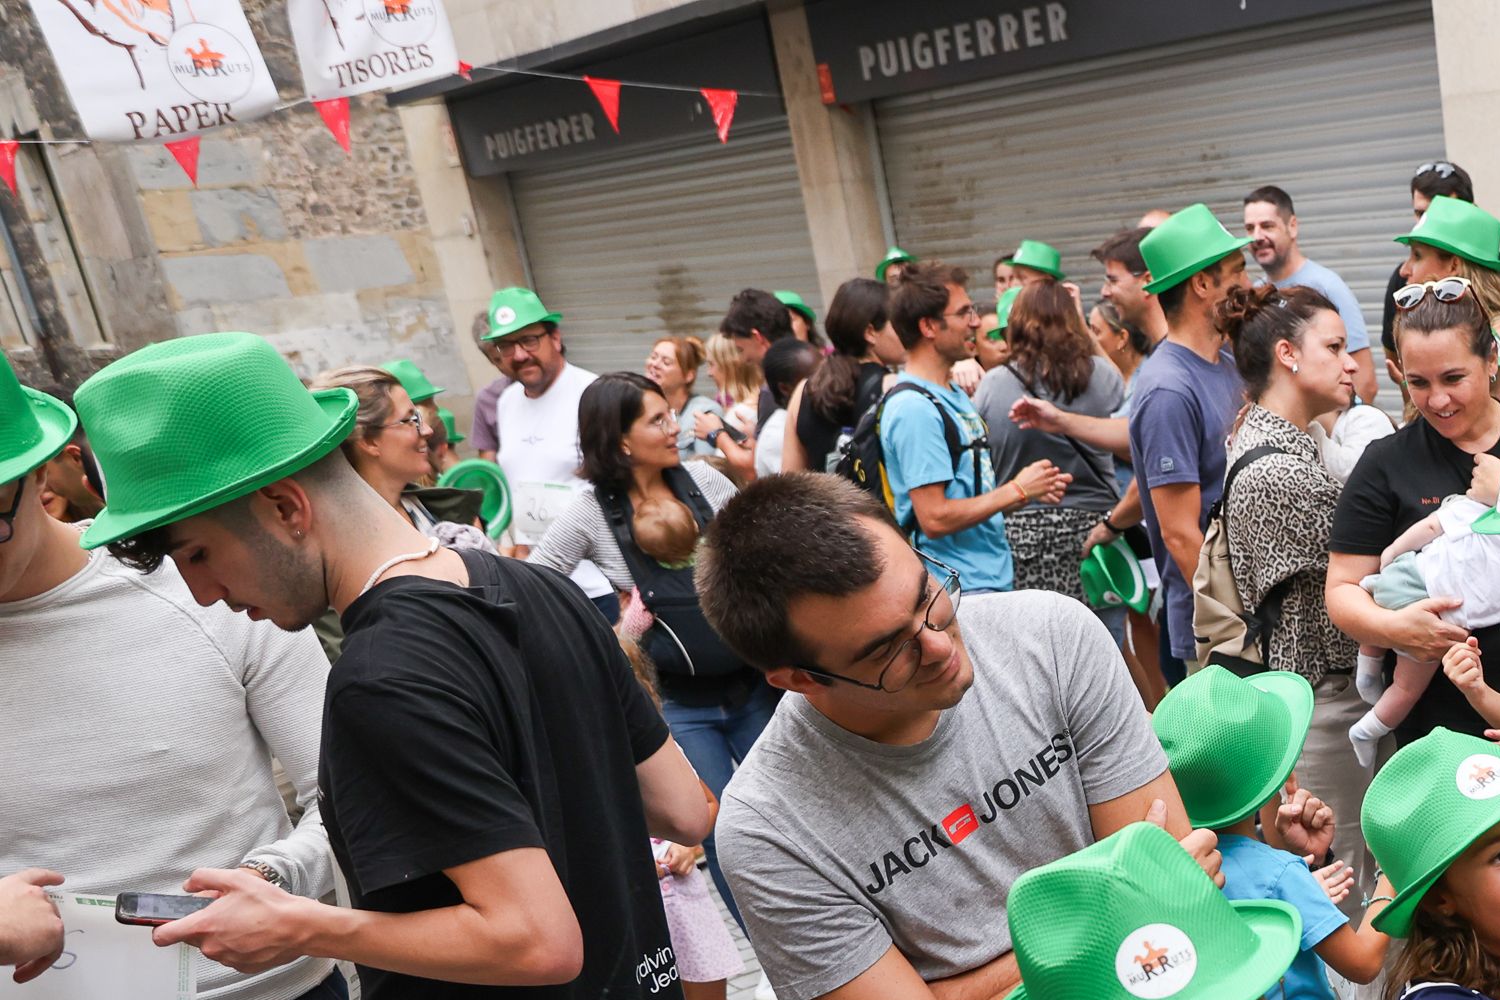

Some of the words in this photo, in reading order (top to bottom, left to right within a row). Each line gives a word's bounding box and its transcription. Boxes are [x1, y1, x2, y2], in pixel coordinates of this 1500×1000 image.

[857, 2, 1068, 81] PUIGFERRER
[329, 43, 435, 88] TISORES
[125, 100, 238, 140] PAPER
[864, 825, 953, 895] JACK
[979, 732, 1074, 825] JONES
[650, 964, 679, 993] Jea
